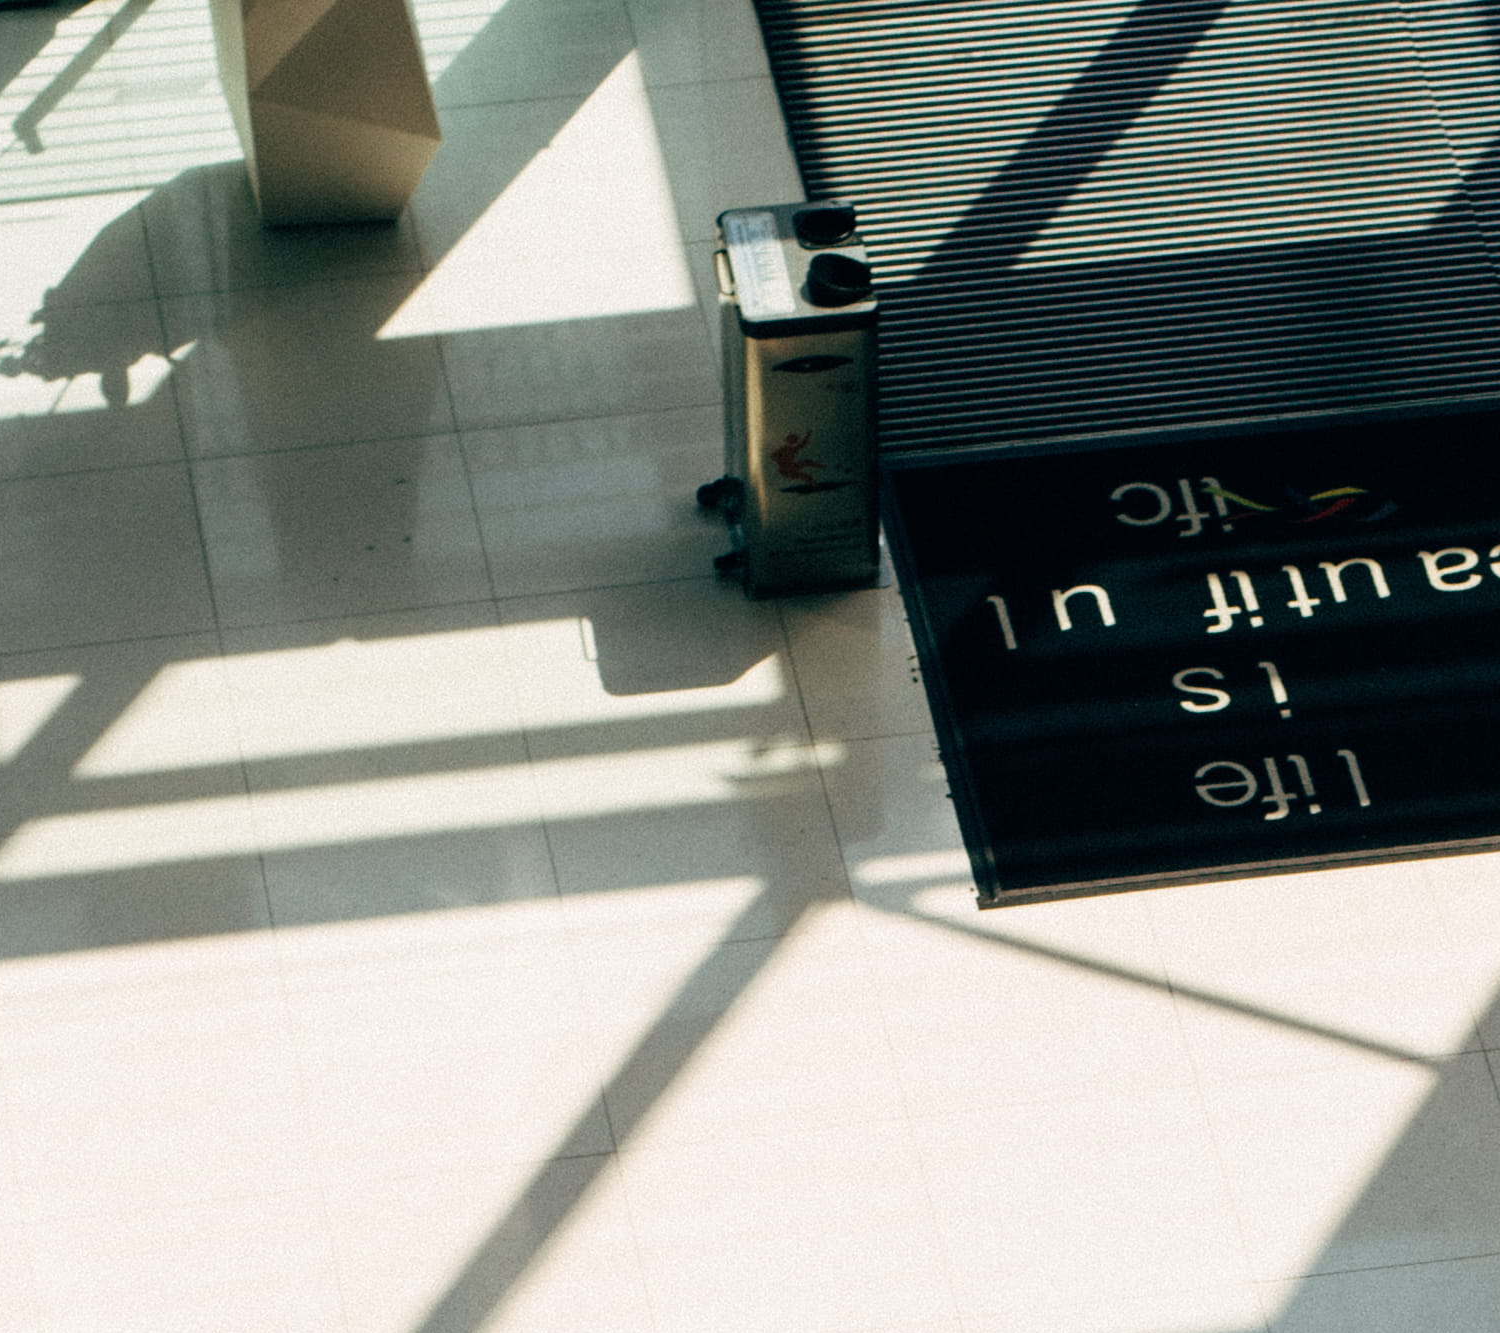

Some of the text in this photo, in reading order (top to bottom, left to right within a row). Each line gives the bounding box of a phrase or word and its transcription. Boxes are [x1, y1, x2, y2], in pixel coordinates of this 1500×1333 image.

[1109, 474, 1234, 538] ifc
[1170, 660, 1293, 720] is
[1193, 748, 1372, 822] life
